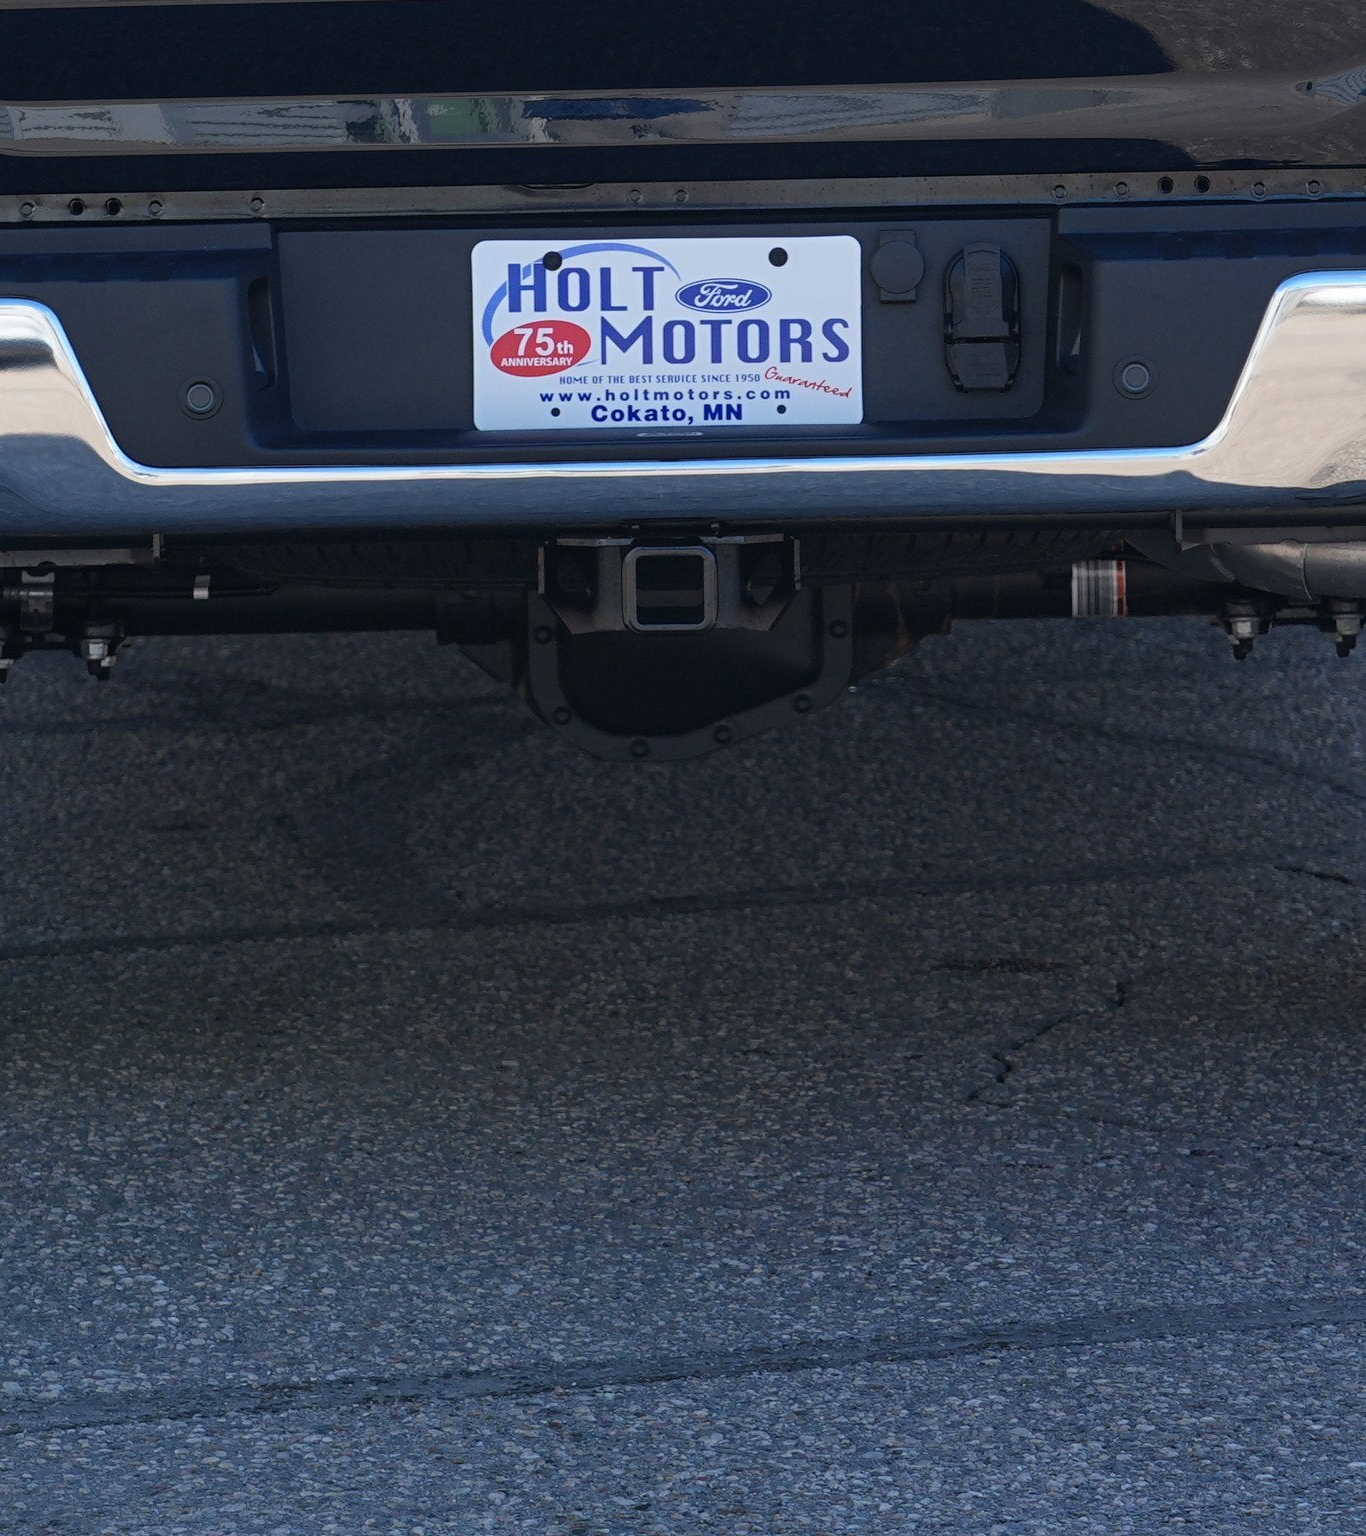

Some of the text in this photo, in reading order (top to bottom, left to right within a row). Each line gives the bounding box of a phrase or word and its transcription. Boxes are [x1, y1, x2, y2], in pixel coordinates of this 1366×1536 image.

[507, 262, 754, 313] HOLT Ford
[513, 327, 575, 357] 75th
[600, 315, 851, 365] MOTORS
[500, 356, 574, 368] ANNIVERSARY
[559, 373, 761, 385] HOME OF THE BEST SERVICE SINCE 1950
[764, 366, 853, 399] Guaranteed
[539, 388, 791, 403] www.holtmotors.com
[590, 403, 743, 425] Cokato, MN
